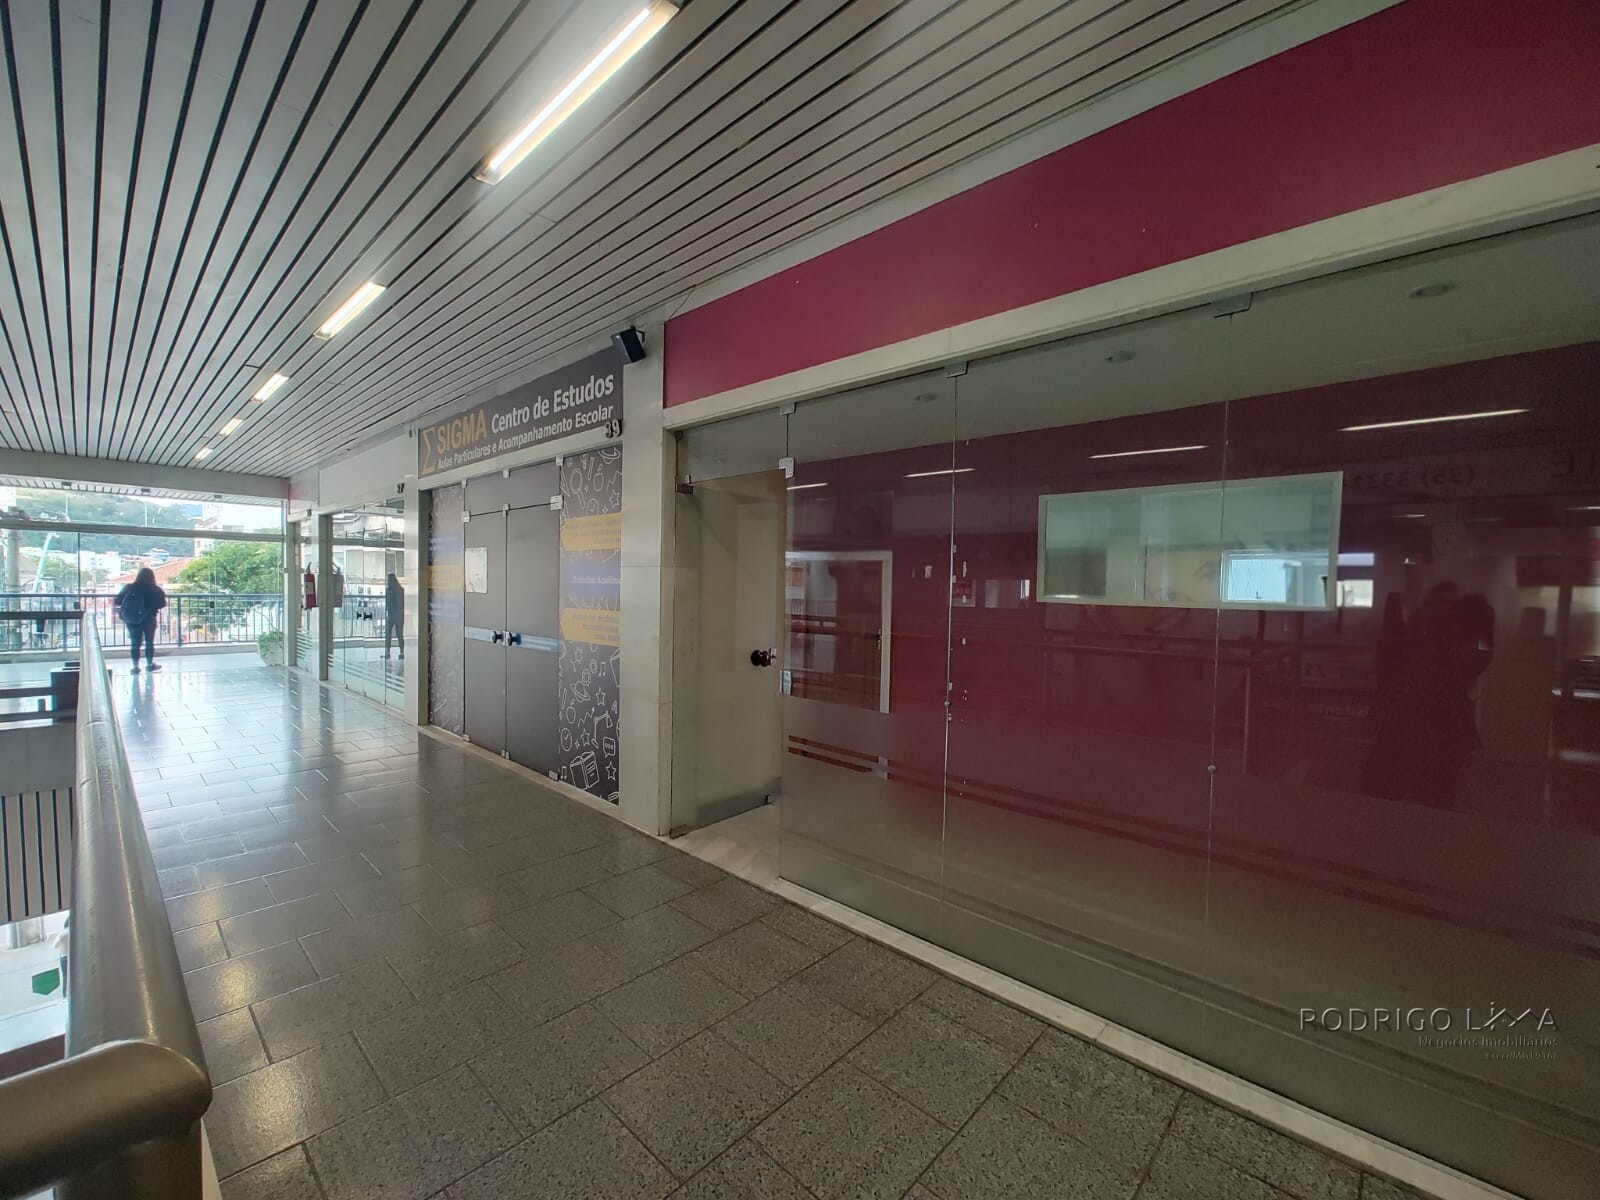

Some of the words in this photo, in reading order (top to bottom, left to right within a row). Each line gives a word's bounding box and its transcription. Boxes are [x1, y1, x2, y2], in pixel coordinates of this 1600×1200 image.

[437, 409, 488, 454] SIGMA
[491, 406, 530, 434] Centro
[533, 396, 550, 419] de
[553, 374, 614, 413] Estudos
[437, 455, 453, 470] Aulas
[454, 444, 491, 466] Particulares
[498, 419, 572, 451] Acompanhamento
[575, 405, 614, 428] Escolar
[604, 419, 623, 438] 39
